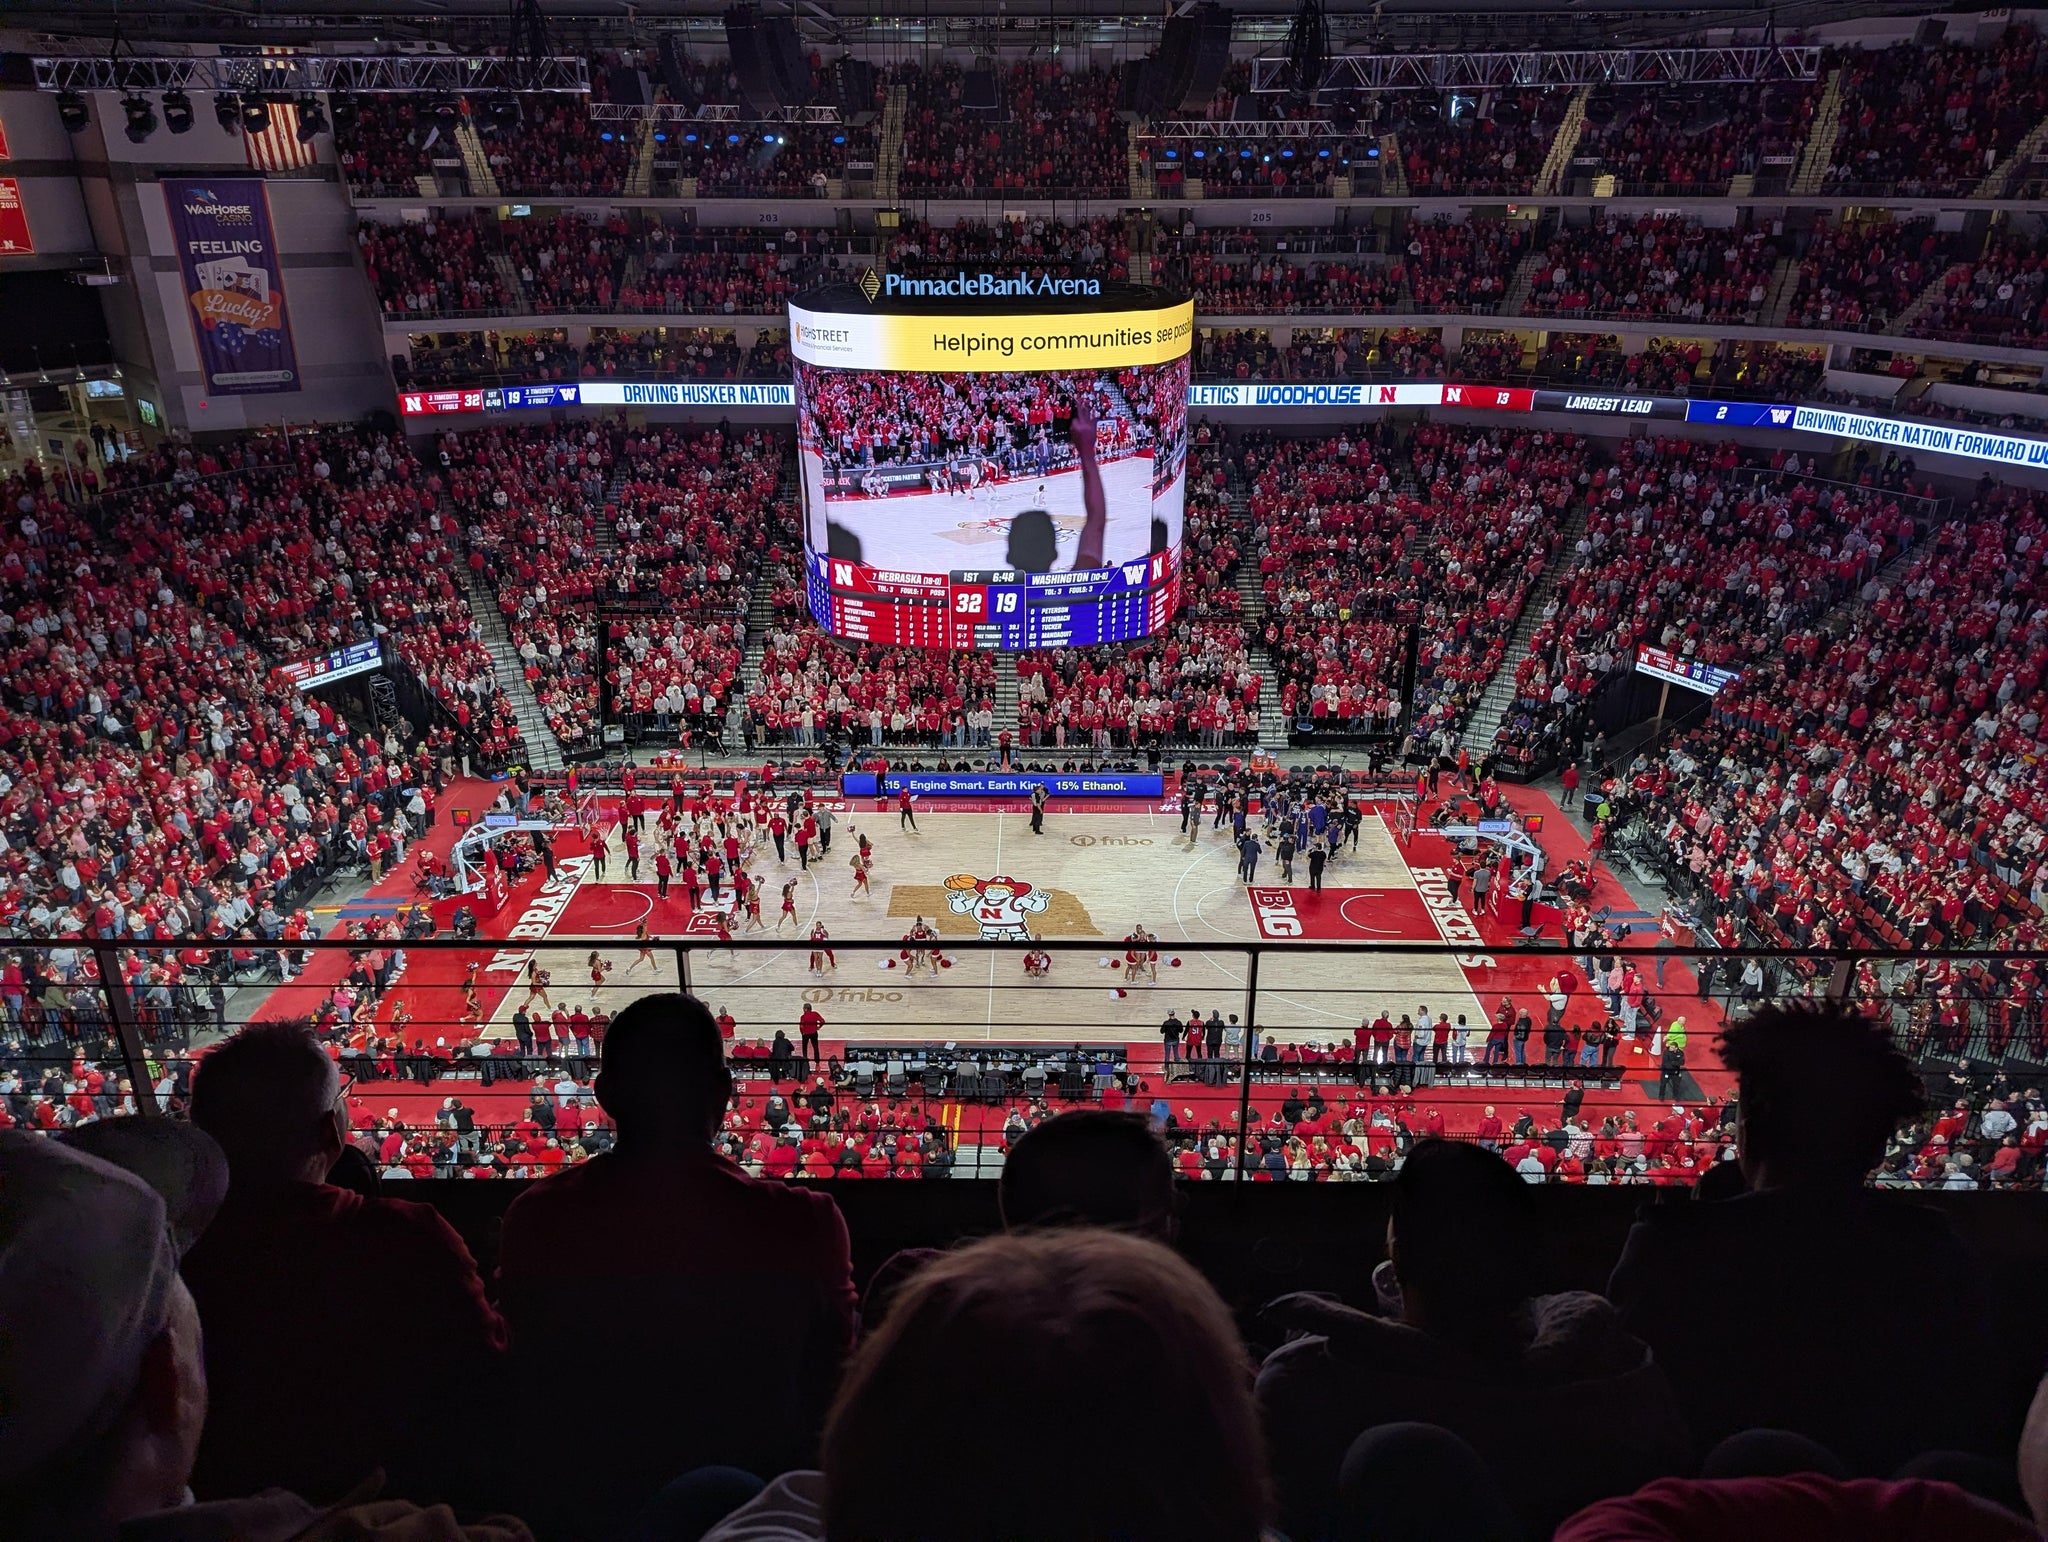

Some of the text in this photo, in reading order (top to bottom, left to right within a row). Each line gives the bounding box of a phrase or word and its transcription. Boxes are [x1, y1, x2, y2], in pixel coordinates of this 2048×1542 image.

[216, 214, 252, 222] CASINO
[760, 214, 778, 222] 203
[1252, 214, 1272, 222] 205
[4, 240, 14, 250] N
[189, 240, 262, 254] FEELING
[886, 272, 1100, 296] PinnacleBank Arena
[204, 294, 273, 325] Lucky?
[800, 326, 849, 342] HIGHSTREET
[934, 333, 1014, 356] Helping
[1020, 328, 1152, 350] communities
[1156, 329, 1172, 343] see
[464, 394, 480, 407] 32
[508, 392, 520, 404] 19
[560, 388, 576, 400] W
[624, 385, 790, 403] DRIVING HUSKER NATION
[1256, 386, 1361, 404] WOODHOUSE
[1379, 386, 1396, 402] N
[1446, 388, 1462, 402] N
[1496, 392, 1509, 405] 13
[405, 398, 422, 412] N
[1566, 396, 1652, 414] LARGEST LEAD
[1716, 406, 1728, 420] 2
[1770, 409, 1792, 424] W
[1796, 410, 1846, 432] DRIVING
[1848, 417, 1900, 442] HUSKER
[1902, 426, 1952, 450] NATION
[1954, 434, 2026, 460] FORWARD
[902, 473, 921, 482] PARTNER
[835, 564, 853, 586] N
[1123, 564, 1146, 585] W
[1152, 556, 1162, 581] N
[878, 572, 922, 584] NEBRASKA
[964, 572, 1014, 582] 1ST 6:48
[1032, 572, 1089, 585] WASHINGTON
[956, 593, 982, 612] 32
[996, 593, 1017, 613] 19
[368, 648, 378, 657] W
[1640, 653, 1649, 663] N
[314, 658, 342, 674] 32 19
[1674, 664, 1702, 679] 32 19
[910, 781, 947, 791] Engine
[950, 781, 984, 790] Smart.
[988, 781, 1016, 790] Earth
[1056, 781, 1126, 790] 15% Ethanol.
[1100, 836, 1154, 846] fnbo
[980, 908, 1002, 919] N
[838, 988, 903, 1002] fnbo
